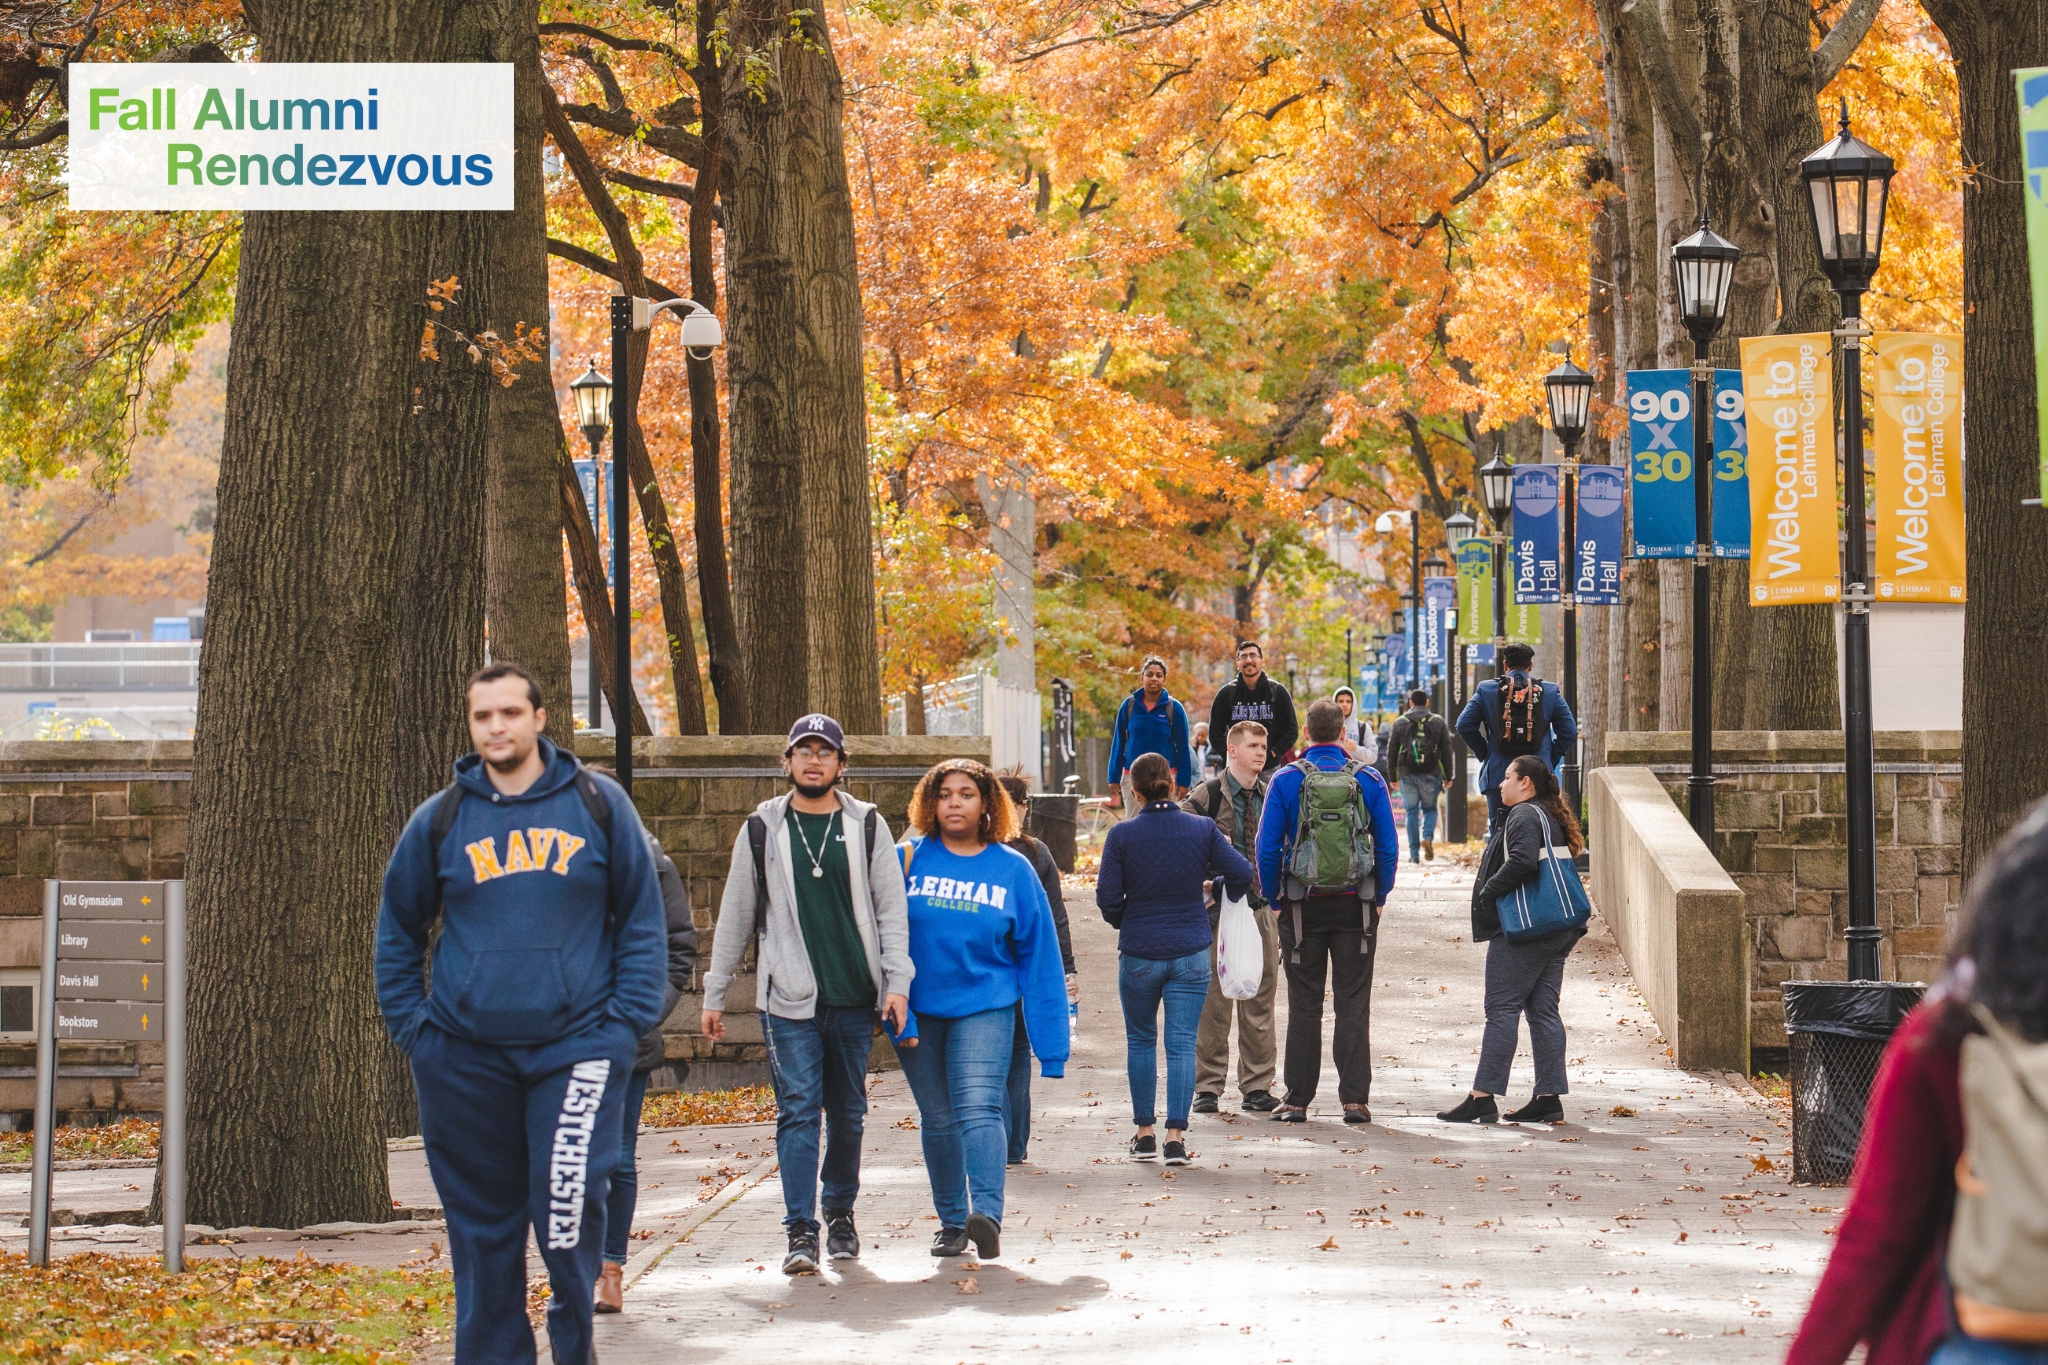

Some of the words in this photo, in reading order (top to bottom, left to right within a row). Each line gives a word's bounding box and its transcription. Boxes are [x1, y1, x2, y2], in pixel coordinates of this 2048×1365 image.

[1766, 361, 1796, 398] to
[1798, 344, 1818, 417] College
[1895, 357, 1926, 394] to
[1927, 343, 1949, 416] College
[1630, 389, 1690, 422] 90
[1715, 389, 1745, 421] 9
[1645, 422, 1678, 450] X
[1634, 450, 1692, 483] 30
[1715, 449, 1750, 482] 3
[1800, 421, 1818, 498] Lehman
[1928, 420, 1946, 497] Lehman
[1767, 406, 1801, 579] Welcome
[1896, 403, 1929, 576] Welcome
[1517, 540, 1535, 592] Davis
[1539, 560, 1557, 591] Hall
[1577, 540, 1597, 592] Davis
[1600, 561, 1618, 593] Hall
[1771, 586, 1805, 595] LEHMAN
[1896, 585, 1931, 593] LEHMAN
[1469, 578, 1480, 636] Anniversary
[1427, 597, 1438, 658] Bookstore
[465, 827, 586, 884] NAVY
[63, 895, 77, 906] Old
[78, 895, 123, 909] Gymnasium
[906, 875, 1008, 910] LEHMAN
[927, 897, 980, 913] COLLEGE
[61, 934, 89, 949] Library
[60, 975, 81, 986] Davis
[83, 975, 99, 987] Hall
[59, 1015, 98, 1028] Bookstore
[548, 1059, 611, 1251] WESTCHESTER
